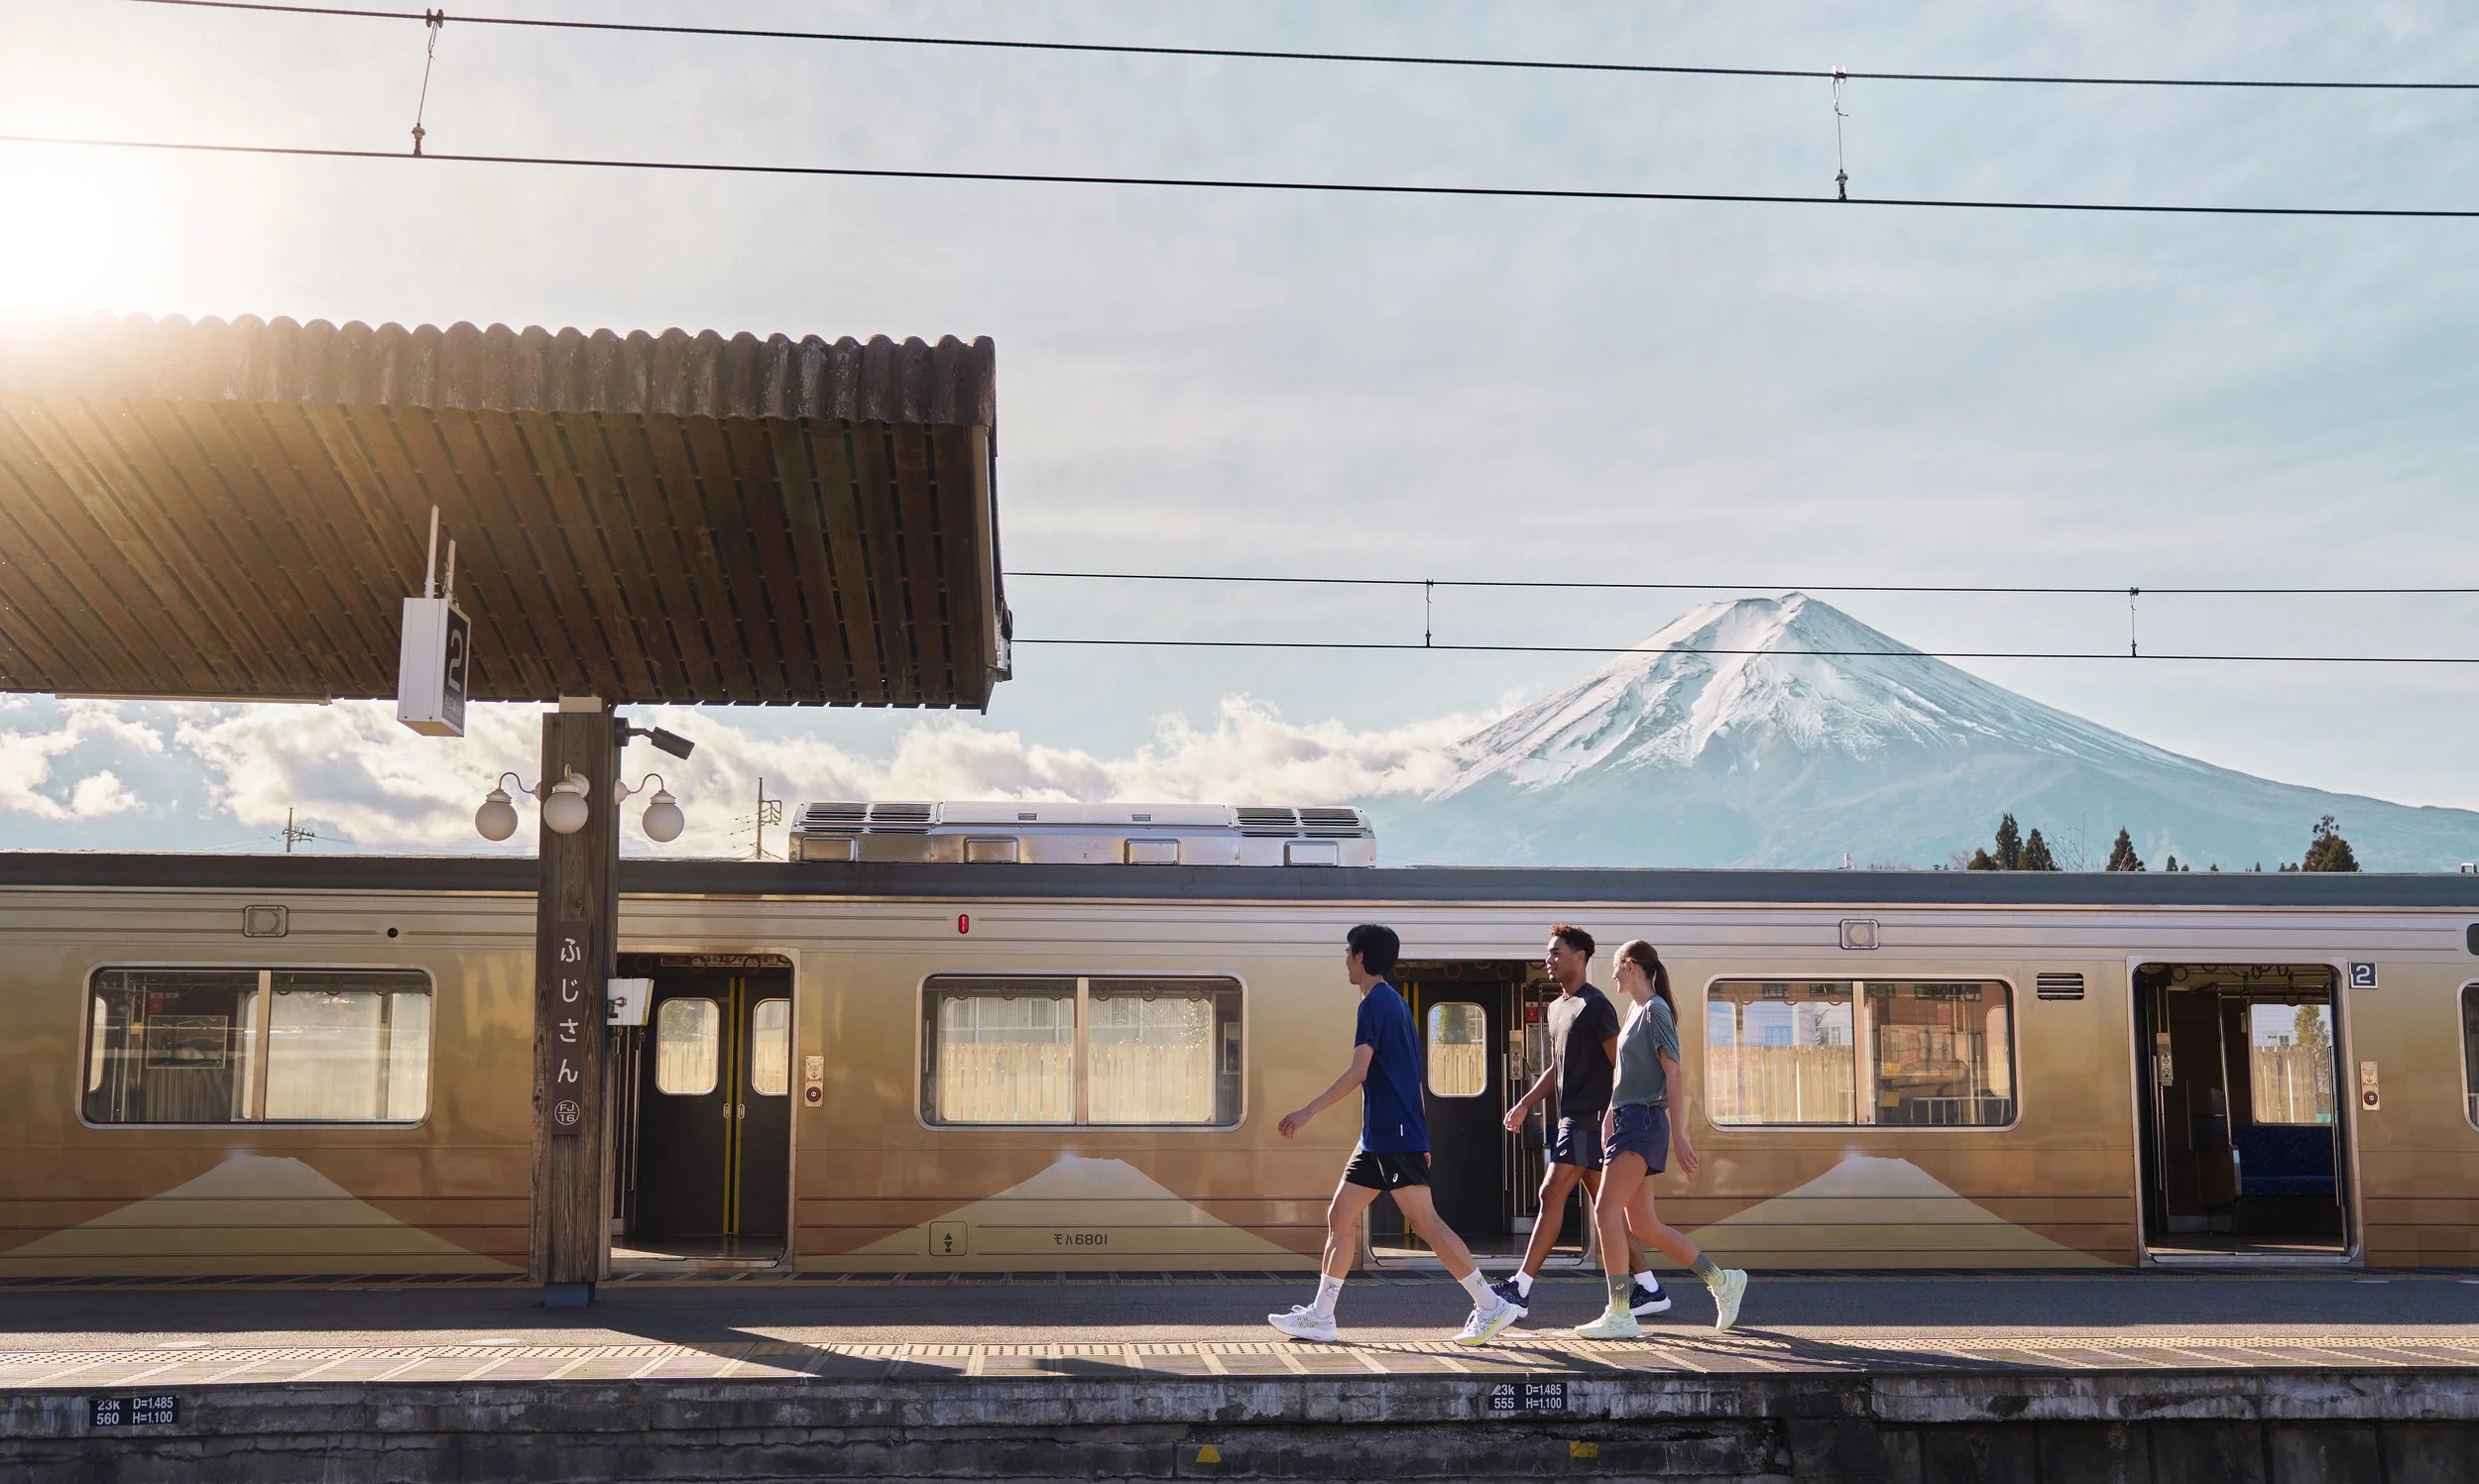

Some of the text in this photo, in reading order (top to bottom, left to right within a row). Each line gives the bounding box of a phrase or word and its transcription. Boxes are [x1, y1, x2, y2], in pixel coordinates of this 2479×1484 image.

[448, 628, 463, 692] 2
[2356, 965, 2371, 984] 2
[557, 938, 581, 1084] ふじさん
[1493, 1397, 1515, 1409] 555
[96, 1412, 120, 1426] 560
